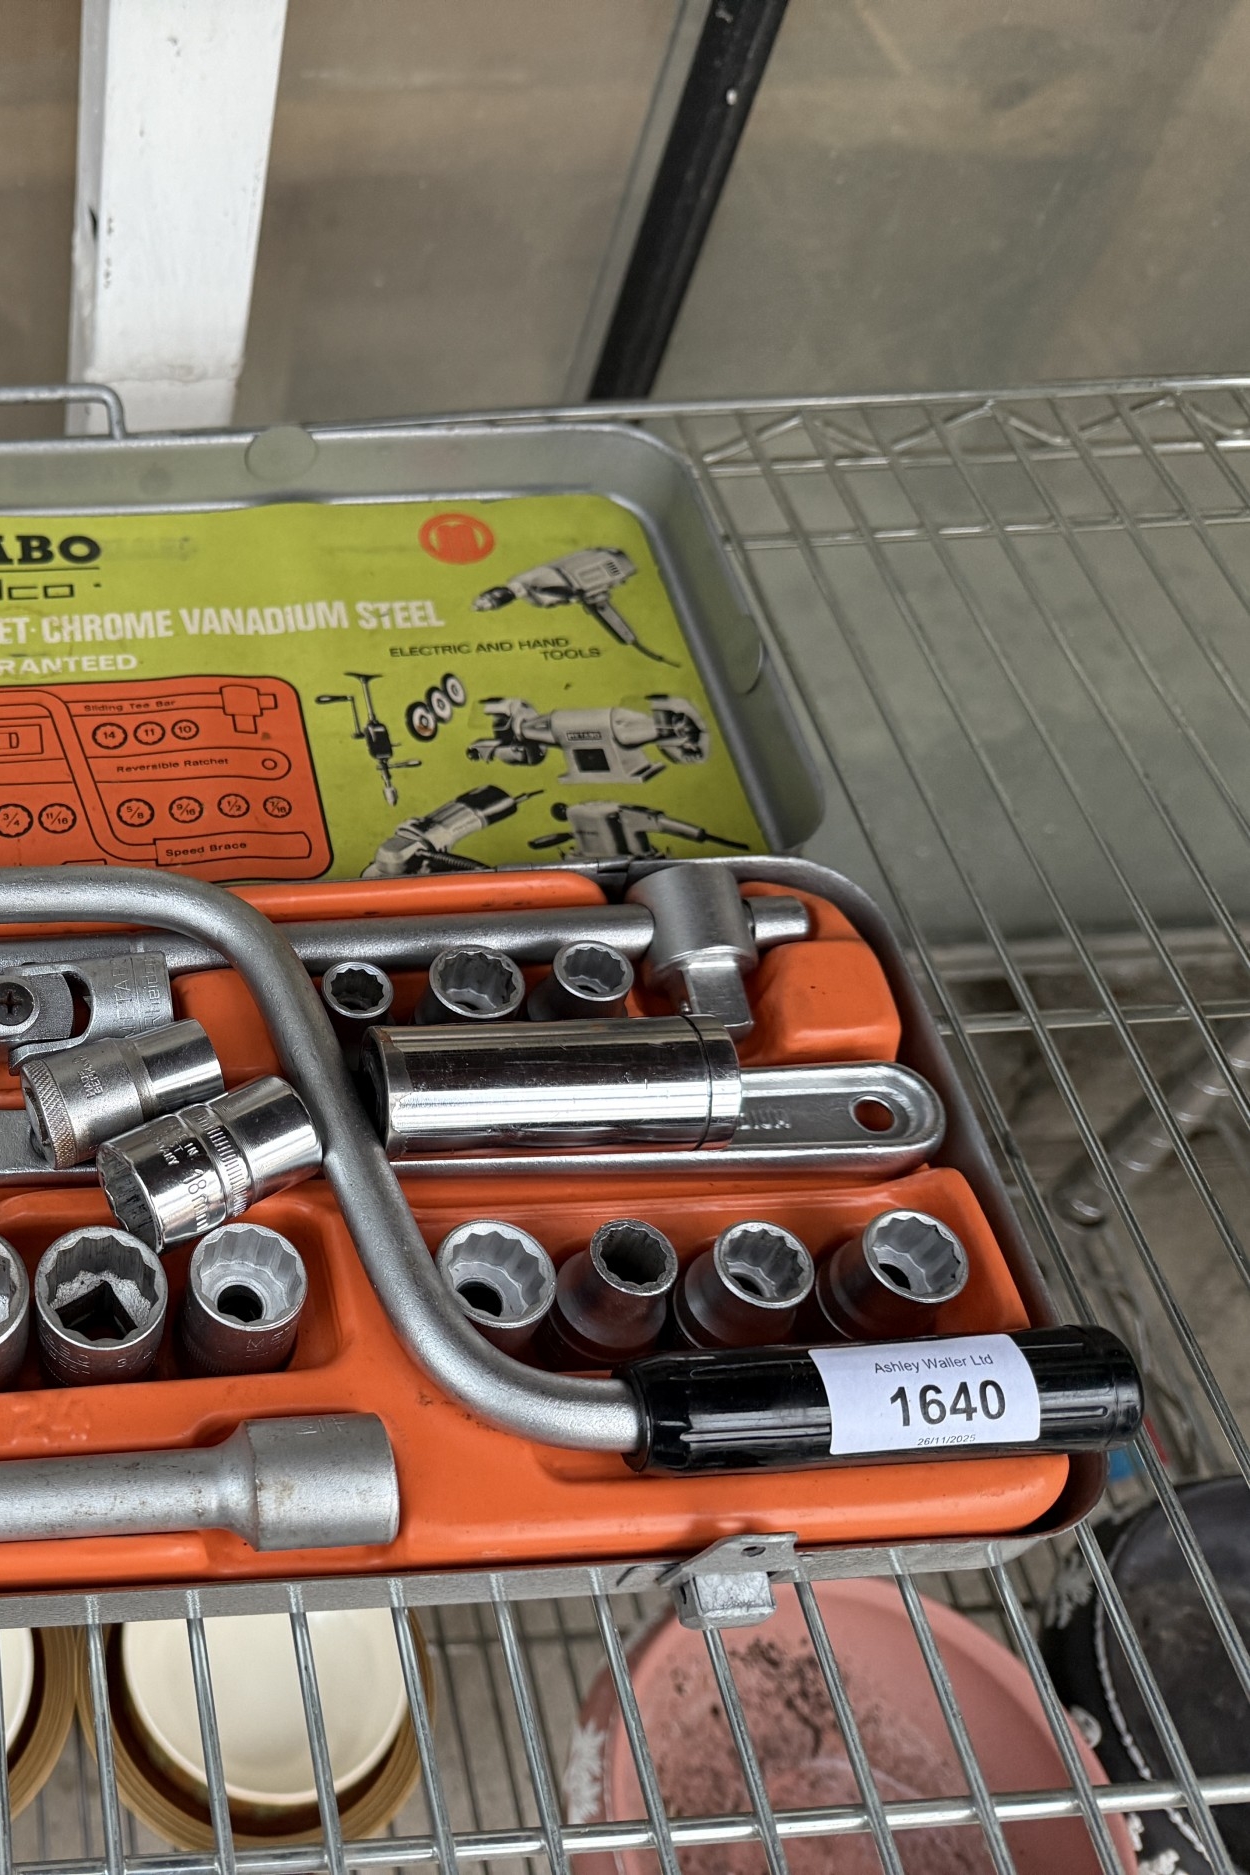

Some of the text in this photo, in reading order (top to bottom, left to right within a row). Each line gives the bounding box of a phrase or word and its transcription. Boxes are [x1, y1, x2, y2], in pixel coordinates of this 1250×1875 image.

[179, 600, 349, 636] VANADIUM
[358, 600, 445, 631] STEEL
[389, 637, 569, 658] ELECTRIC AND HAND
[540, 647, 601, 661] TOOLS
[83, 699, 176, 712] Sliding Tee Bar
[103, 731, 116, 739] 14
[144, 728, 155, 737] 11
[178, 725, 192, 734] 10
[116, 758, 229, 773] Reversible Ratchet
[165, 841, 247, 857] Speed Brace
[183, 1168, 210, 1232] 18mm
[874, 1353, 994, 1375] Ashley Waller Ltd
[889, 1379, 1007, 1427] 1640
[917, 1434, 976, 1446] 26/11/2025
